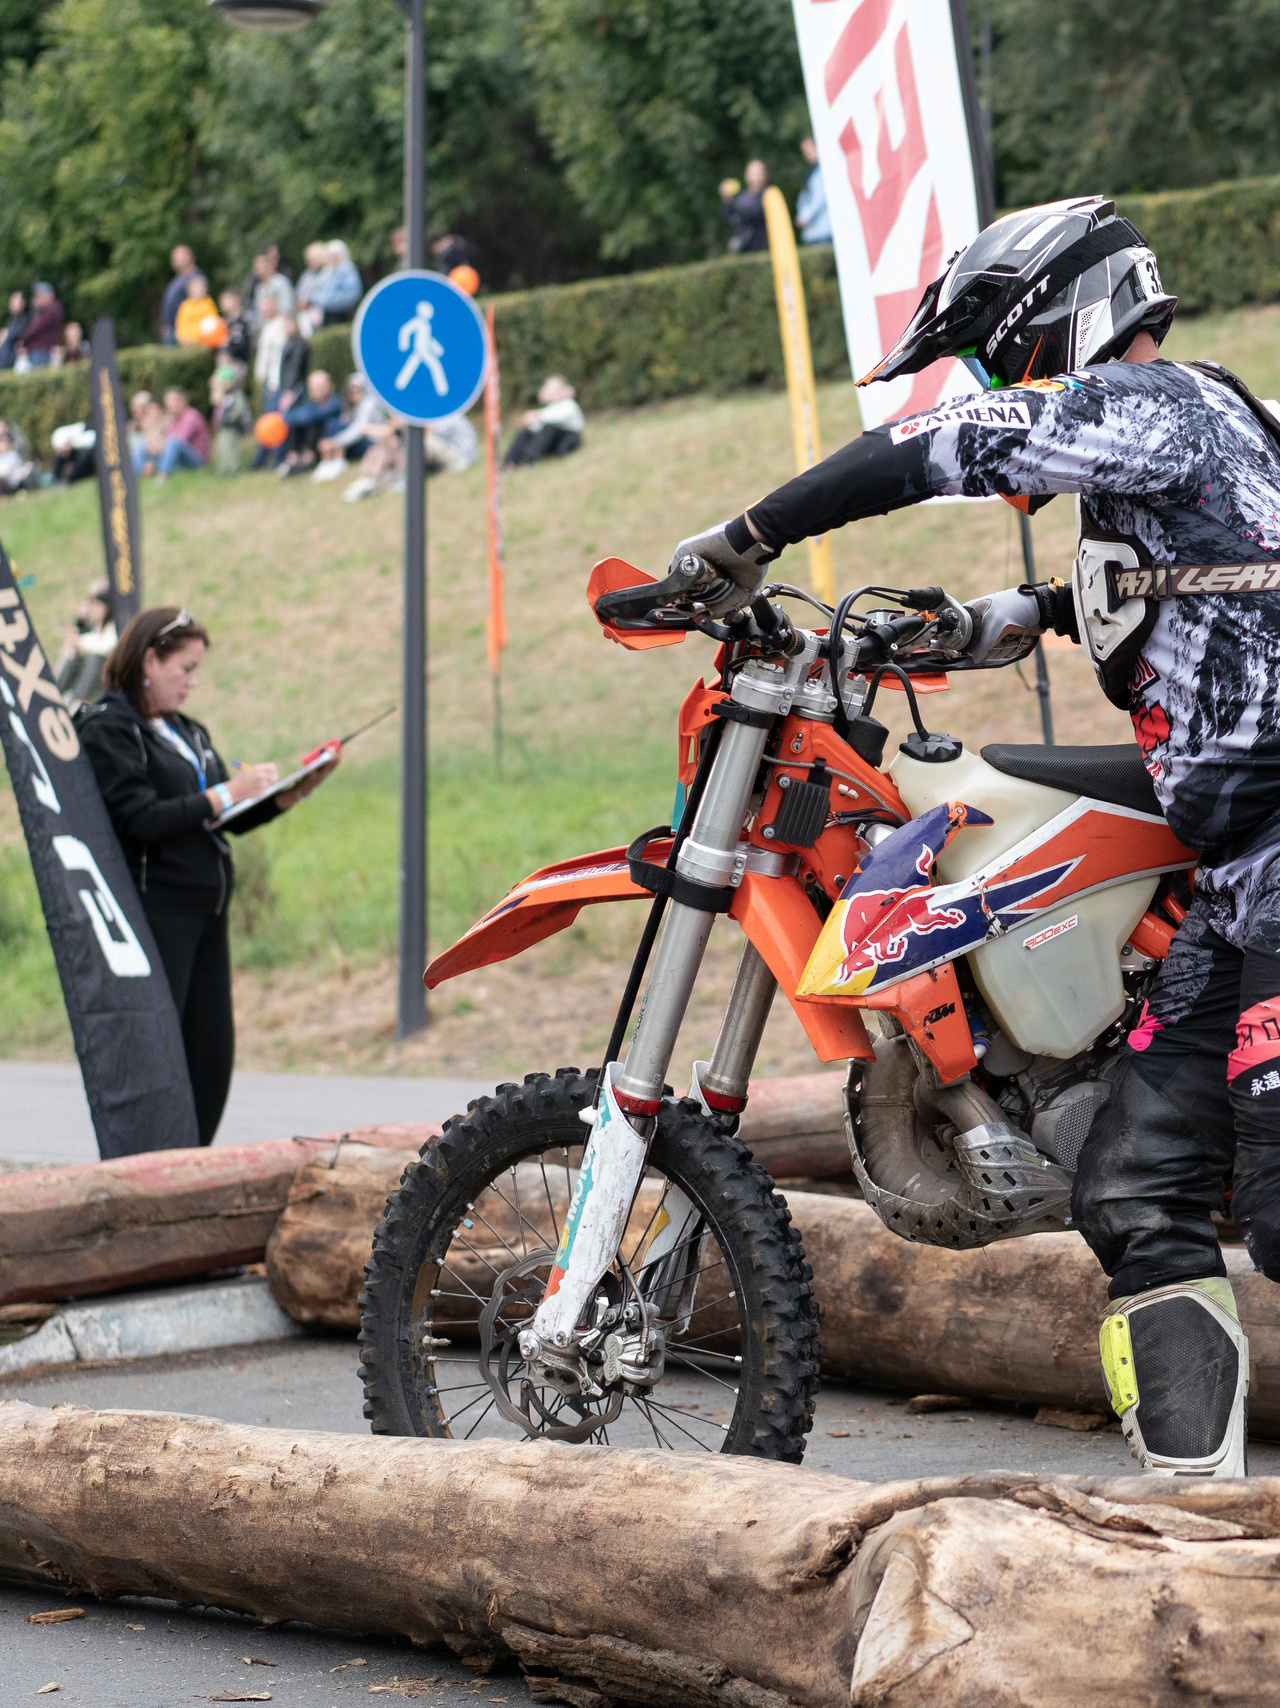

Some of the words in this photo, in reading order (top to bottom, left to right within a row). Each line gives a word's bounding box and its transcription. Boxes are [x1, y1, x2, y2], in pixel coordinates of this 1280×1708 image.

[1145, 260, 1163, 294] 3
[985, 274, 1051, 360] SCOTT
[926, 405, 1026, 425] ATHENA
[1115, 567, 1178, 599] ATT
[923, 1002, 956, 1027] KTM
